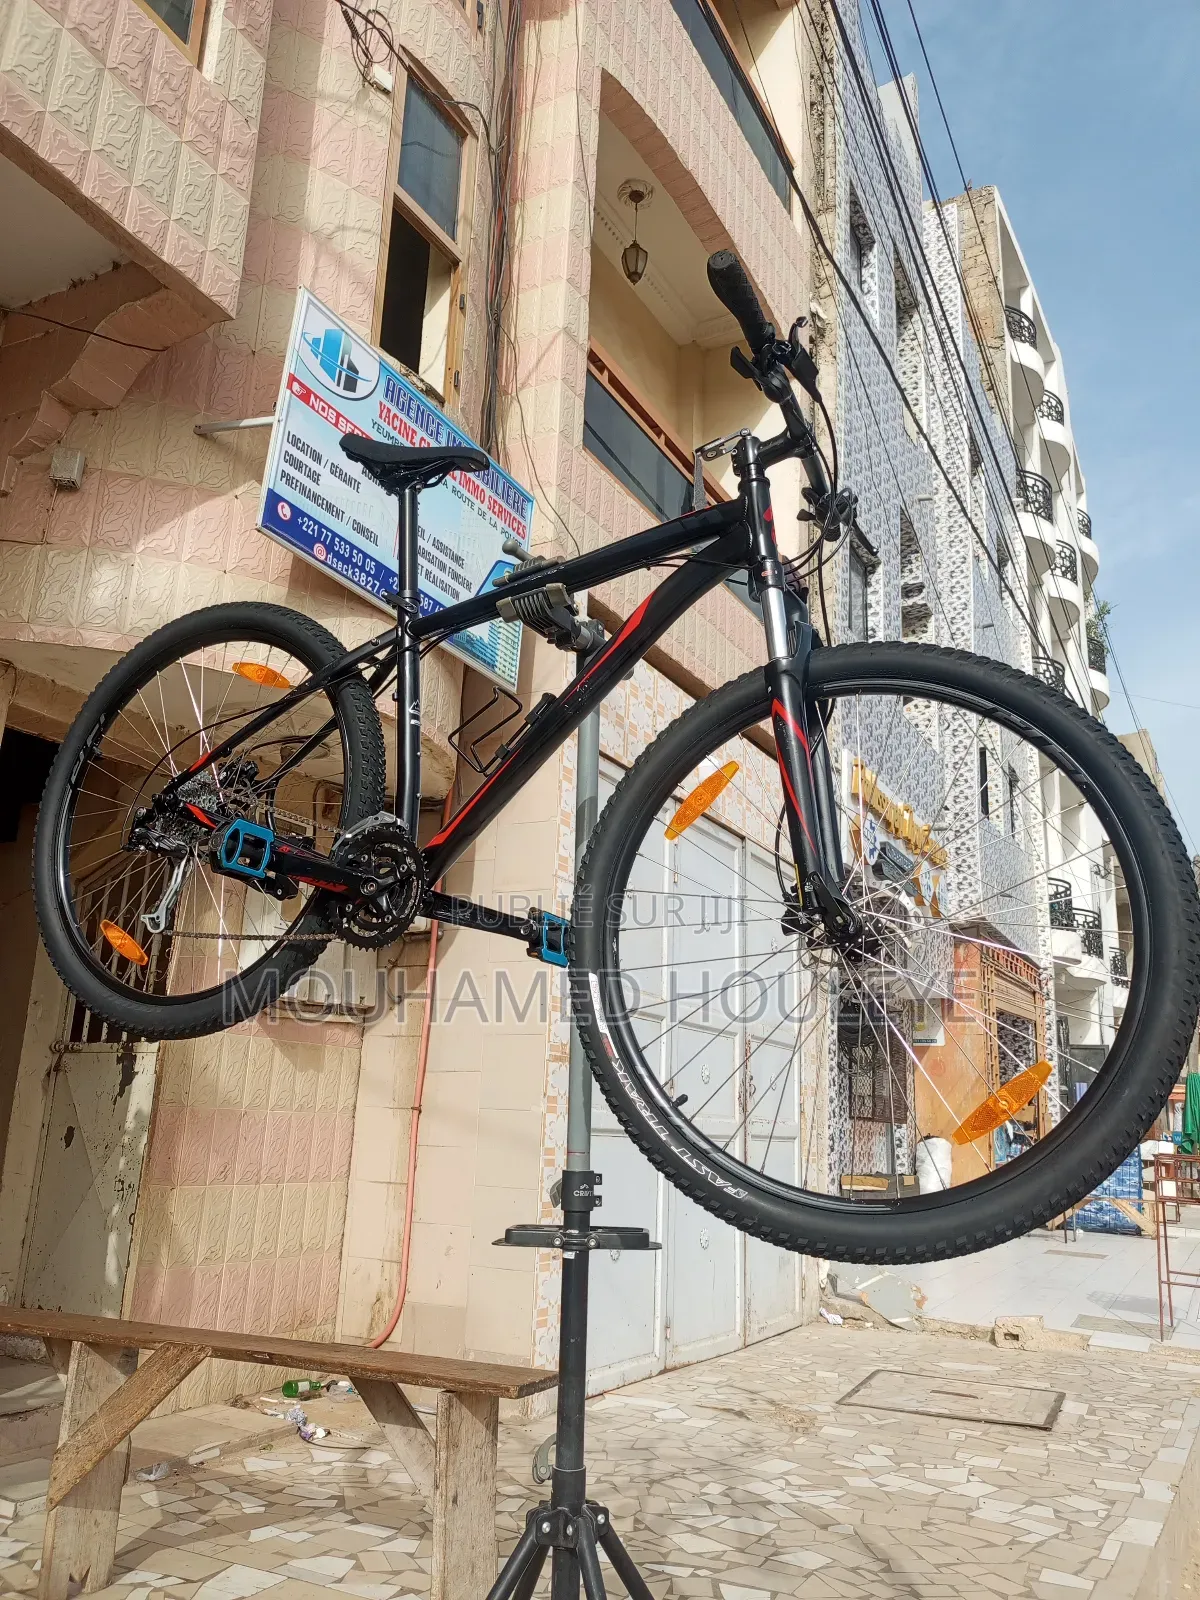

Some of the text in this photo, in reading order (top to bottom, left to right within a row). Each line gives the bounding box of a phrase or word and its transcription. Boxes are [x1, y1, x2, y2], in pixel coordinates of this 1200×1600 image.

[309, 393, 337, 424] NOS
[383, 375, 444, 445] AGENCE
[283, 449, 321, 486] COURTAGE
[286, 430, 323, 467] LOCATION
[329, 462, 362, 494] GÉRANTE
[379, 400, 418, 447] YACINE
[459, 471, 486, 504] IMMO
[487, 495, 527, 541] SERVICES
[280, 469, 345, 523] PREFINANCEMENT
[351, 519, 379, 547] CONSEIL
[452, 485, 475, 511] ROUTE
[477, 507, 487, 520] DE
[489, 517, 498, 531] LA
[297, 517, 318, 537] +221
[321, 528, 332, 545] 77
[334, 537, 350, 557] 533
[352, 550, 363, 566] 50
[365, 559, 376, 575] 05
[432, 537, 465, 569] ASSISTANCE
[424, 568, 460, 602] RÉALISATION
[612, 1057, 749, 1199] FAST TRAK
